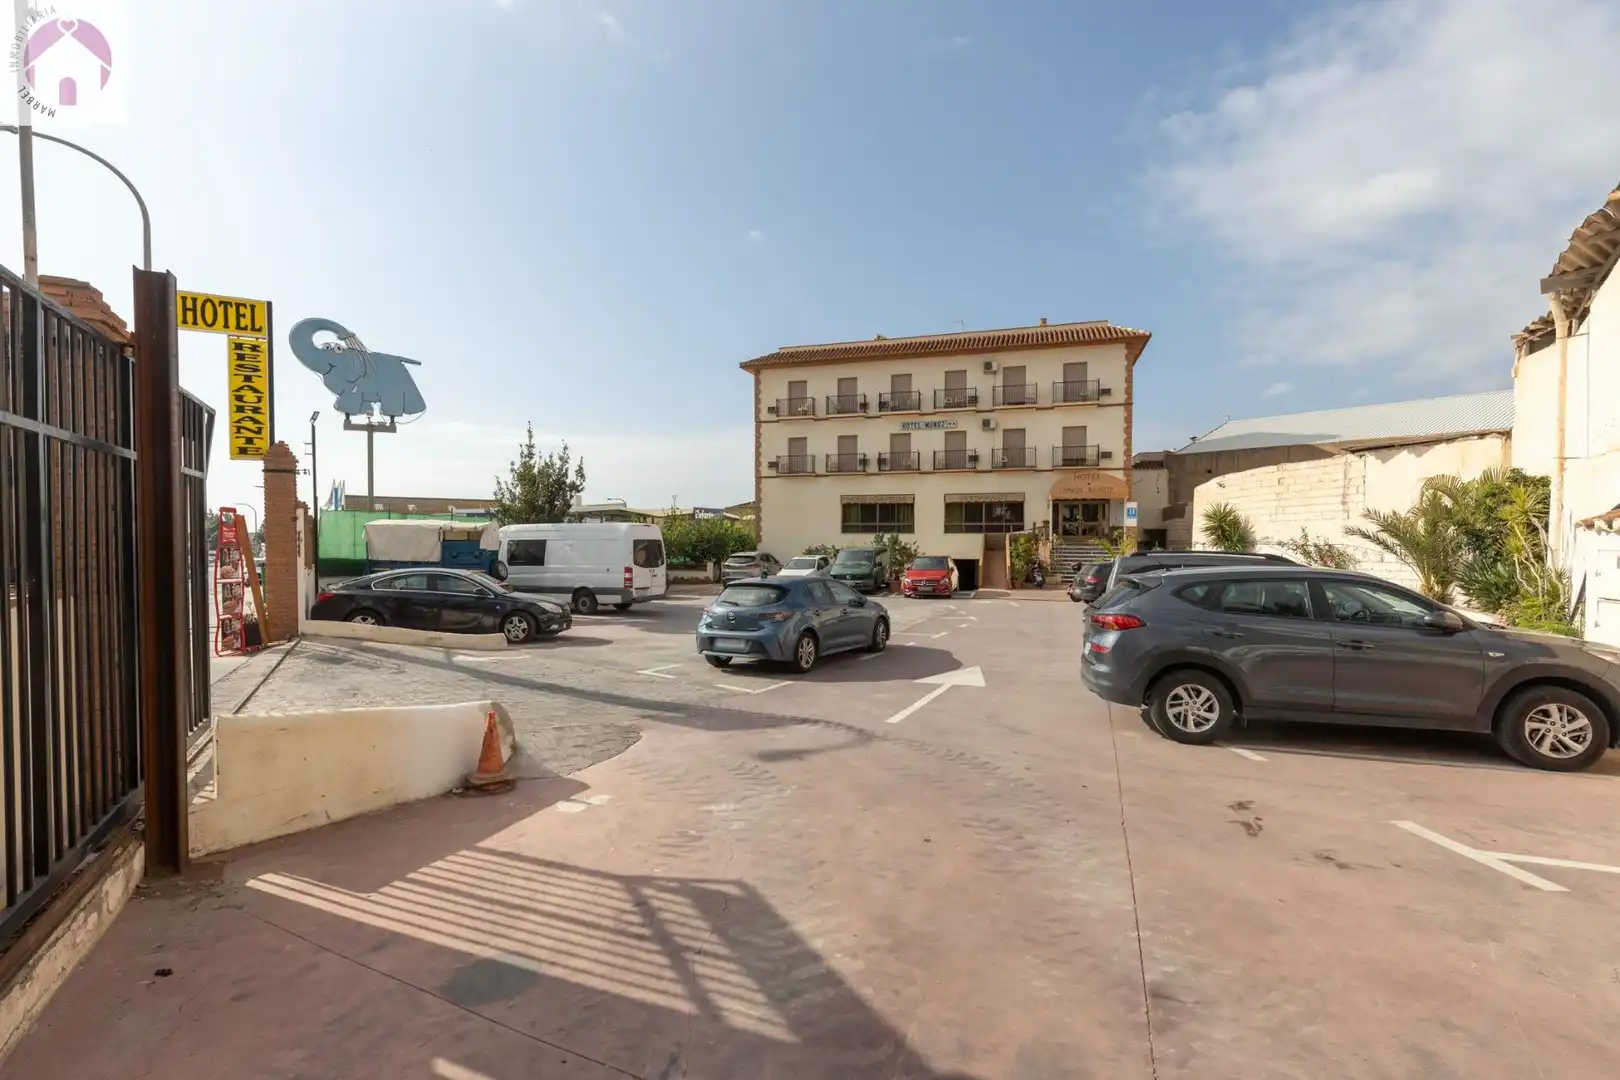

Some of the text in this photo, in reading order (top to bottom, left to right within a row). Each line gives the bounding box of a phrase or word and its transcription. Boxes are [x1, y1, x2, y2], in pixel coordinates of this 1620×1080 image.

[181, 296, 262, 333] HOTEL
[232, 342, 265, 456] RESTAURANTE
[902, 421, 921, 429] HOTEL
[1073, 473, 1100, 481] HOTEL
